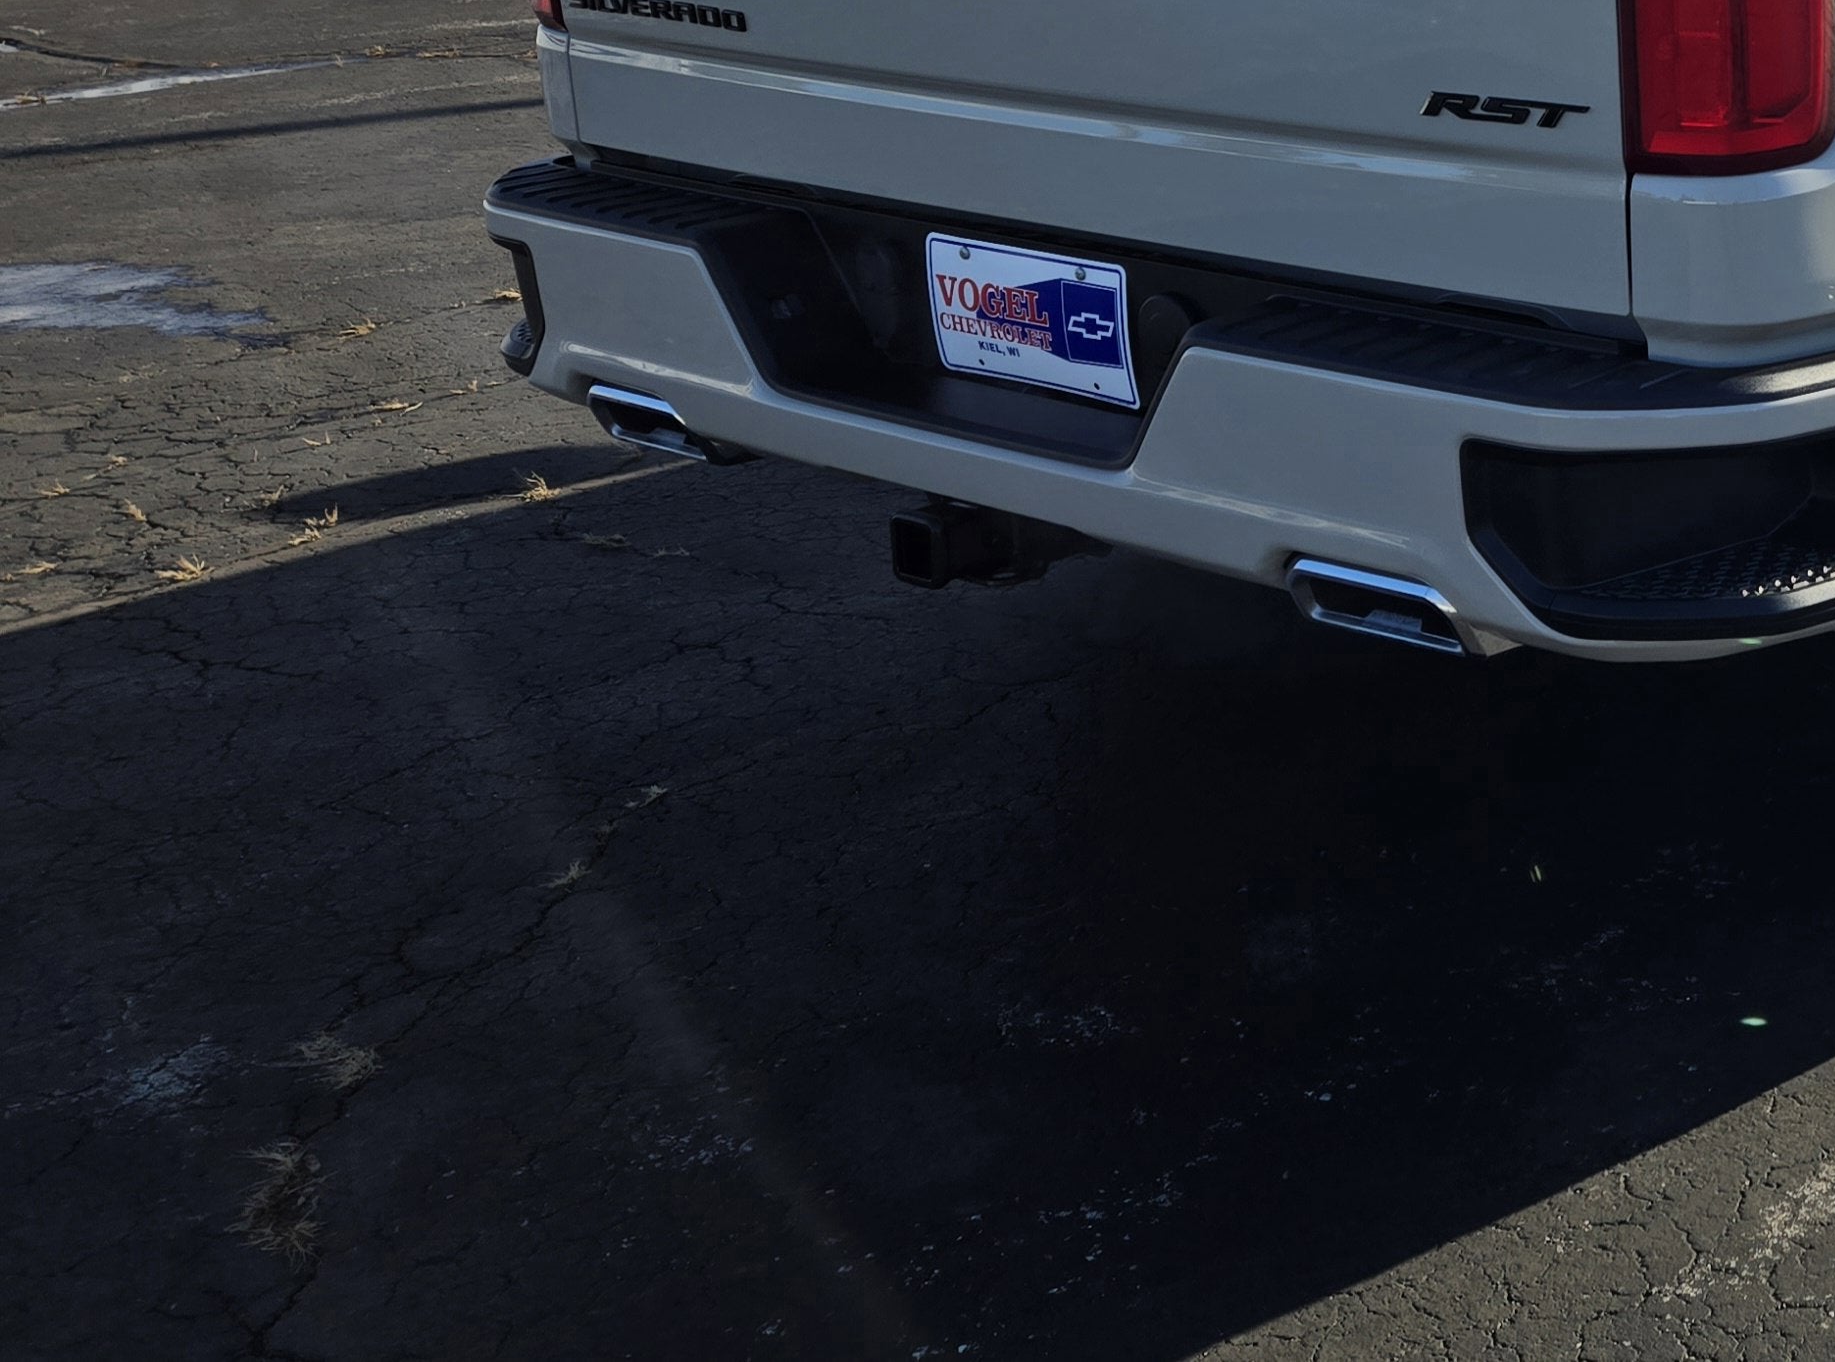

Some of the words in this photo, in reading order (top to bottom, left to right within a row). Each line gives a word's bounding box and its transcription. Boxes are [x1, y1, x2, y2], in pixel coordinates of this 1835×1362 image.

[1420, 91, 1590, 128] RST
[936, 274, 1050, 327] VOGEL
[939, 311, 1053, 351] CHEVROLET
[978, 340, 1006, 357] KIEL,
[1006, 346, 1021, 358] WI
